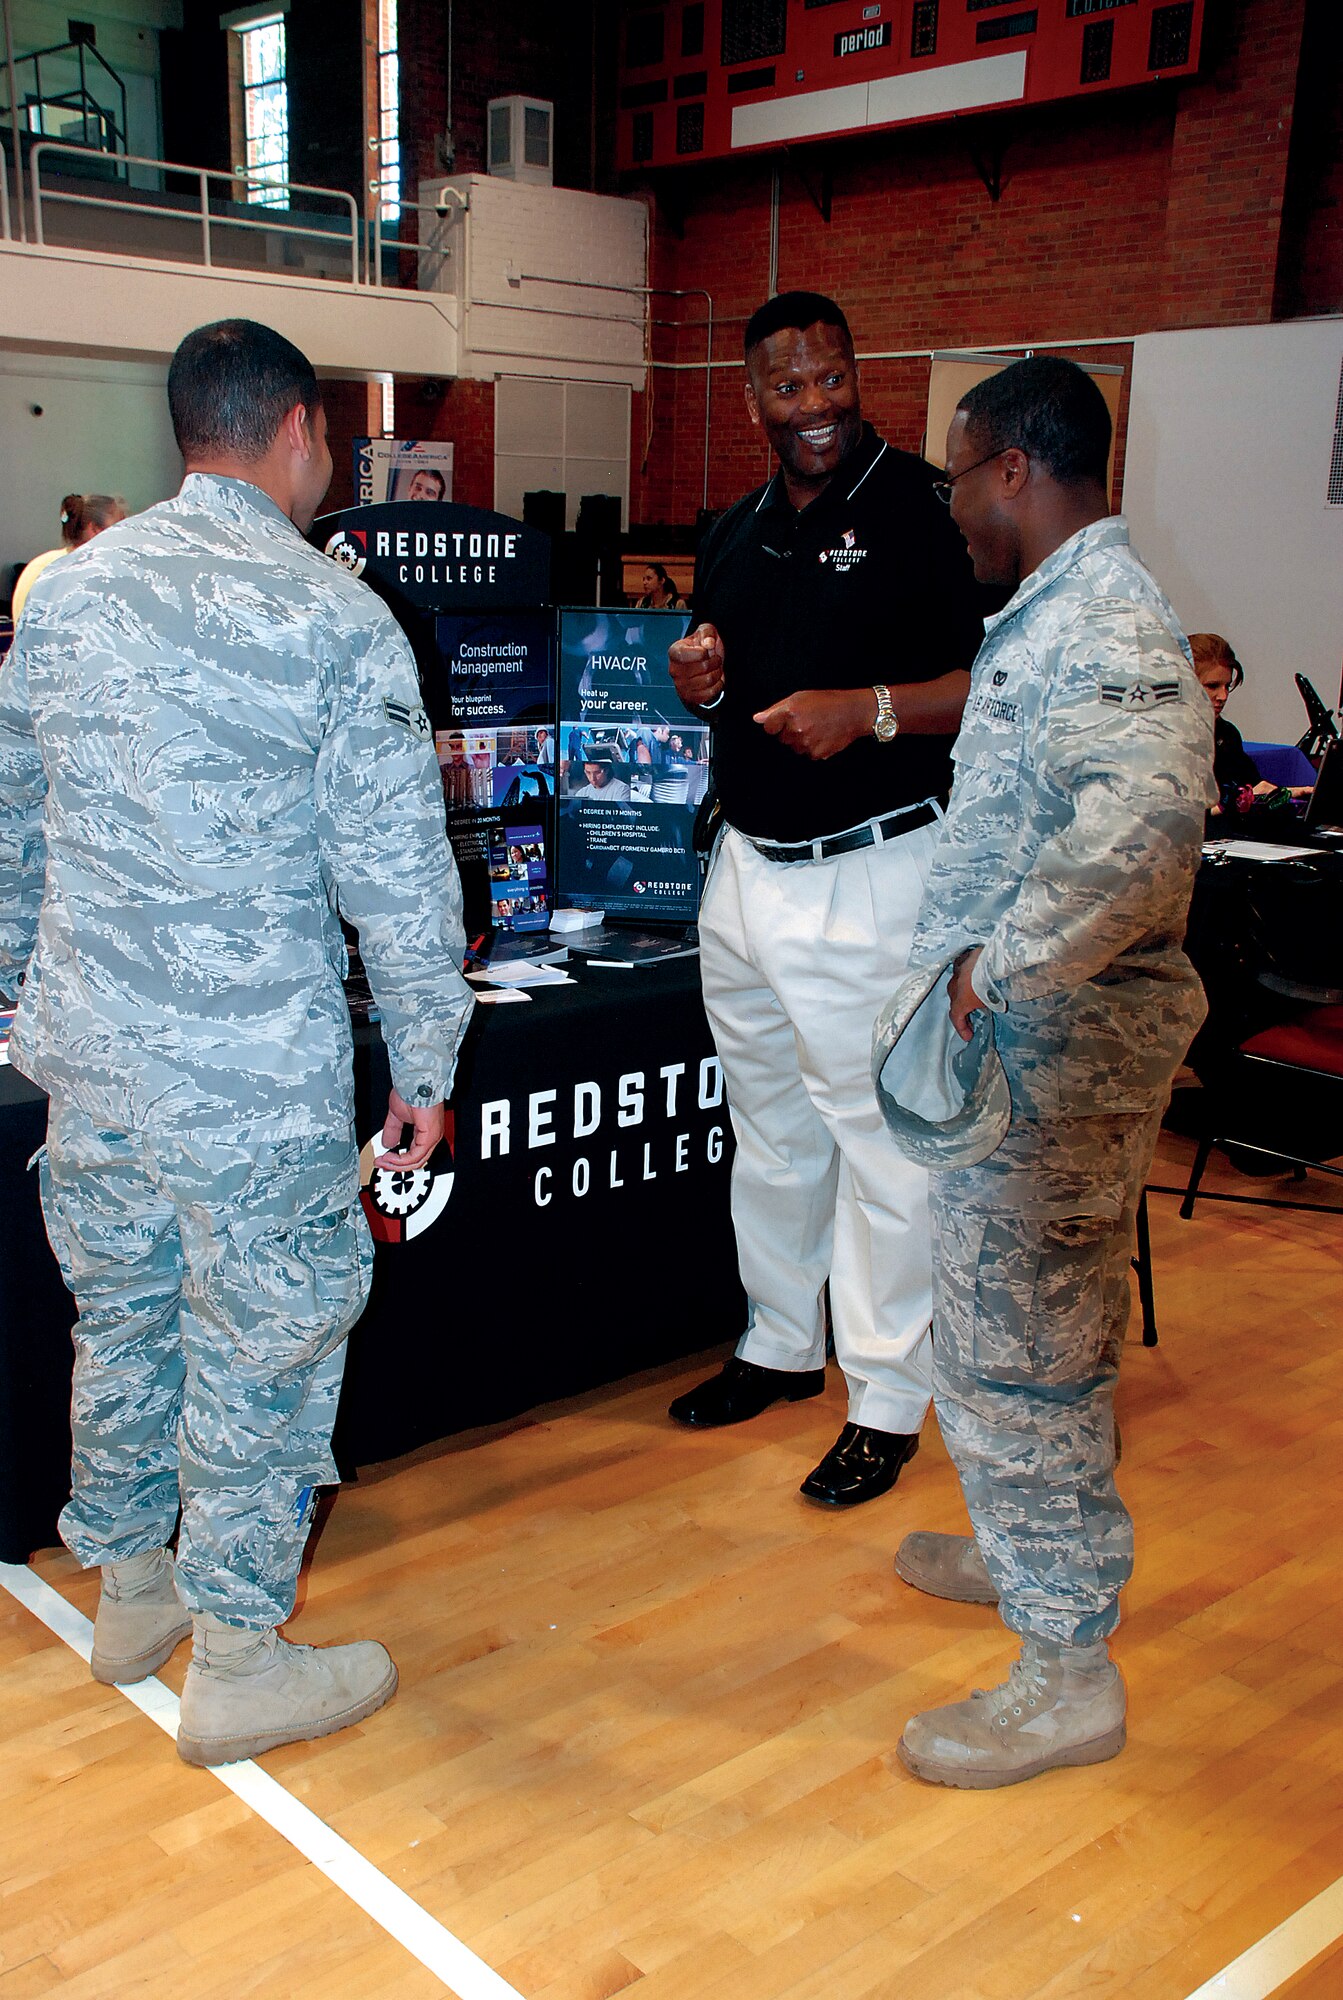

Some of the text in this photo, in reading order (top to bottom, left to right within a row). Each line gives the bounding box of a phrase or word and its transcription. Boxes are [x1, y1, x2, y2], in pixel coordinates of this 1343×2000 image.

[841, 23, 884, 57] period
[835, 563, 851, 571] Staff
[399, 565, 496, 583] COLLEGE
[460, 642, 528, 658] Construction
[451, 660, 523, 677] Management
[591, 655, 647, 671] HVAC/R
[451, 694, 492, 704] Your blueprint
[581, 689, 609, 699] Heat up
[451, 704, 507, 716] for success.
[580, 699, 649, 712] your career.
[482, 815, 501, 823] MONTHS
[582, 822, 601, 830] HIRING
[621, 831, 647, 839] HOSPITAL
[647, 881, 692, 891] REDSTONE
[534, 1126, 723, 1207] COLLEG
